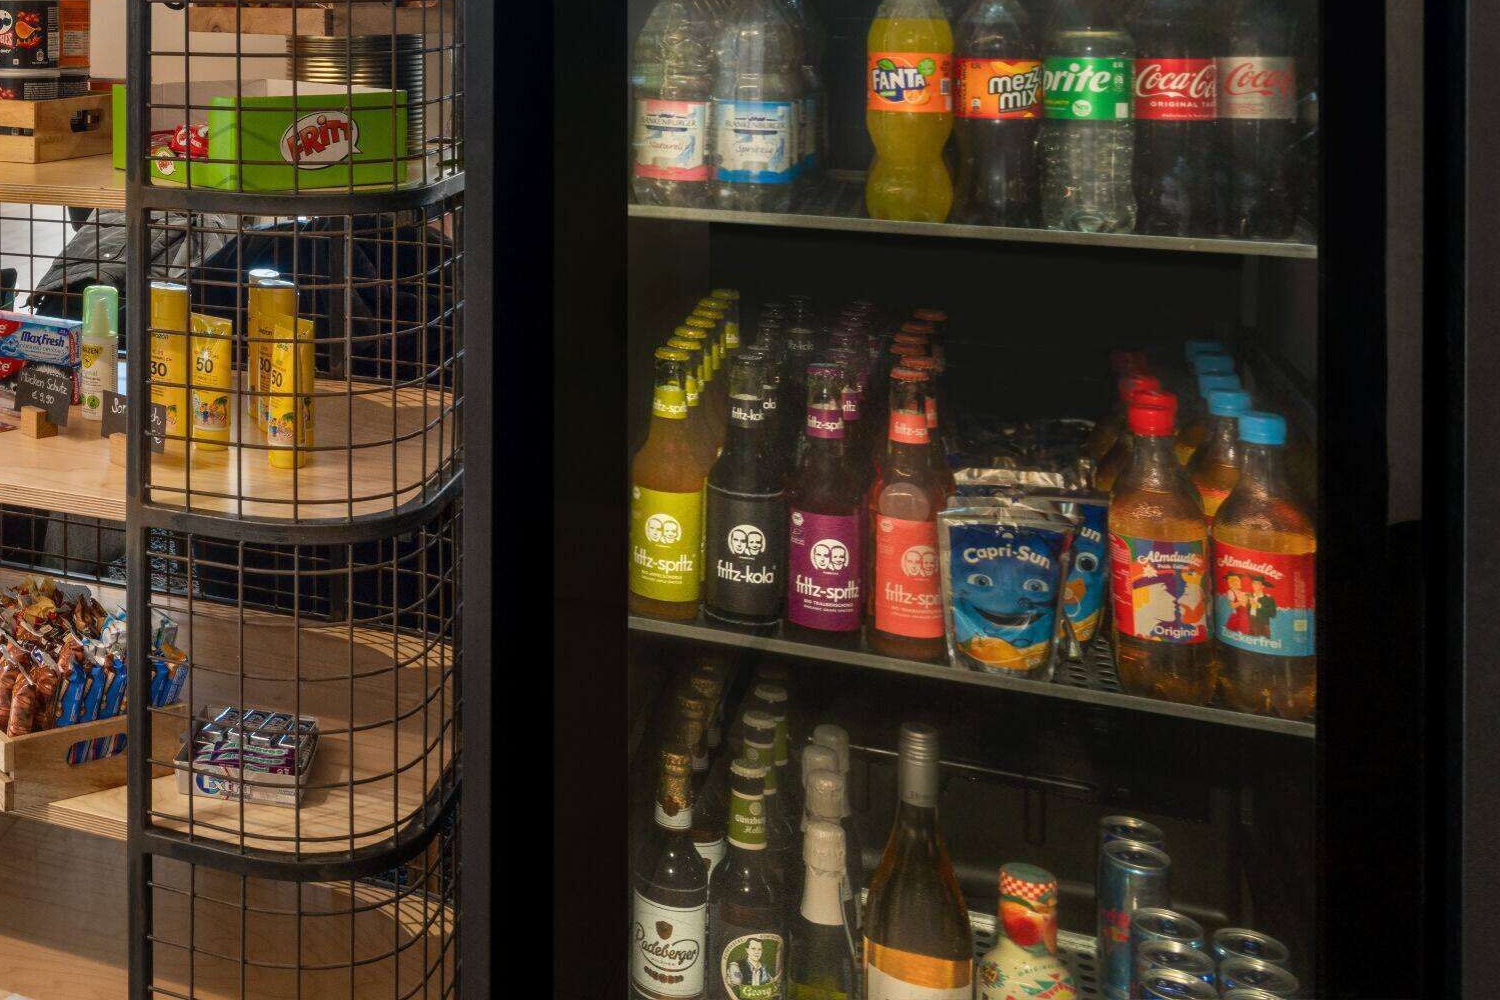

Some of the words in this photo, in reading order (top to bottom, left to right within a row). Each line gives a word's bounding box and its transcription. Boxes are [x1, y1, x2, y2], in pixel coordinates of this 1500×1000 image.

[872, 67, 926, 92] FANTA
[999, 87, 1038, 111] mix
[196, 357, 214, 374] 50
[633, 545, 694, 574] fritz-spritz
[963, 543, 1051, 570] Capri-Sun
[1218, 554, 1285, 580] Almdudler
[717, 559, 774, 584] fritz-kola
[795, 574, 860, 602] fritz-spritz
[1154, 625, 1199, 640] Original
[1221, 626, 1282, 649] Zuckerfrei
[635, 921, 699, 966] Radeberger
